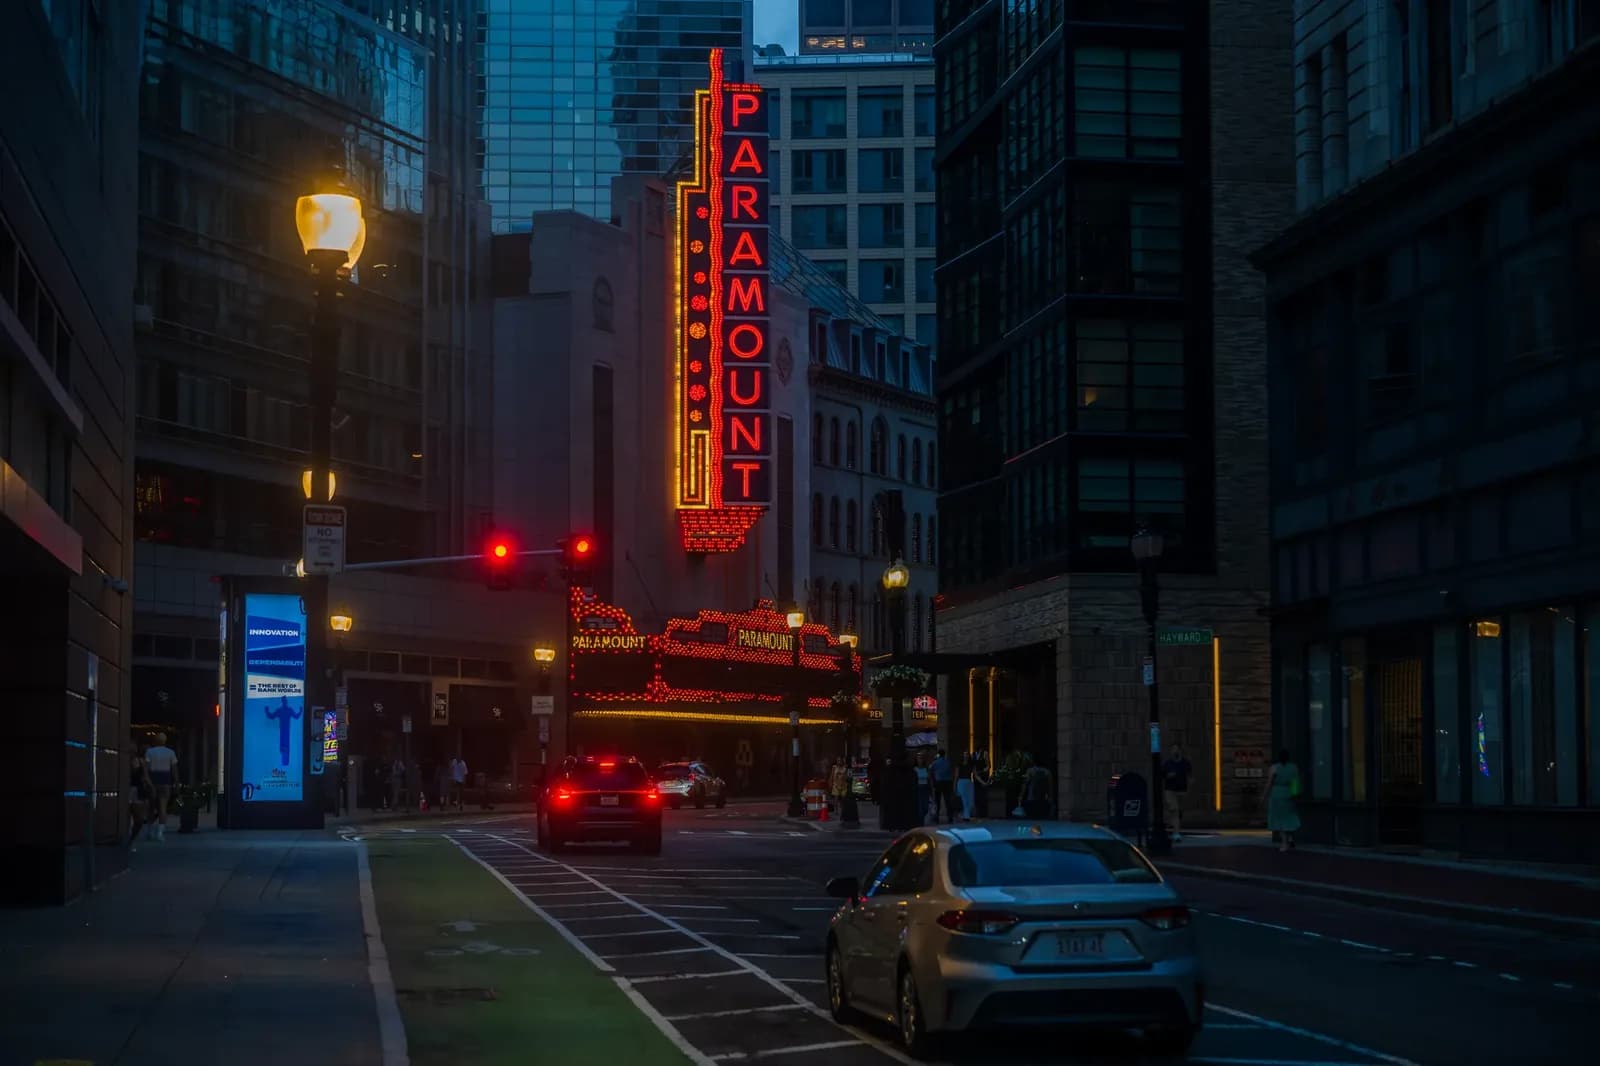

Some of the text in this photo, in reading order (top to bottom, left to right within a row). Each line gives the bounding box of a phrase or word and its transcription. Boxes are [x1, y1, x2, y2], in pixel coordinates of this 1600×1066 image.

[727, 92, 765, 499] PARAMOUNT
[249, 629, 299, 637] INNOVATION
[738, 628, 795, 652] PARAMOUNT
[1160, 631, 1201, 642] HAYWARD
[571, 635, 647, 650] PARAMOUNT
